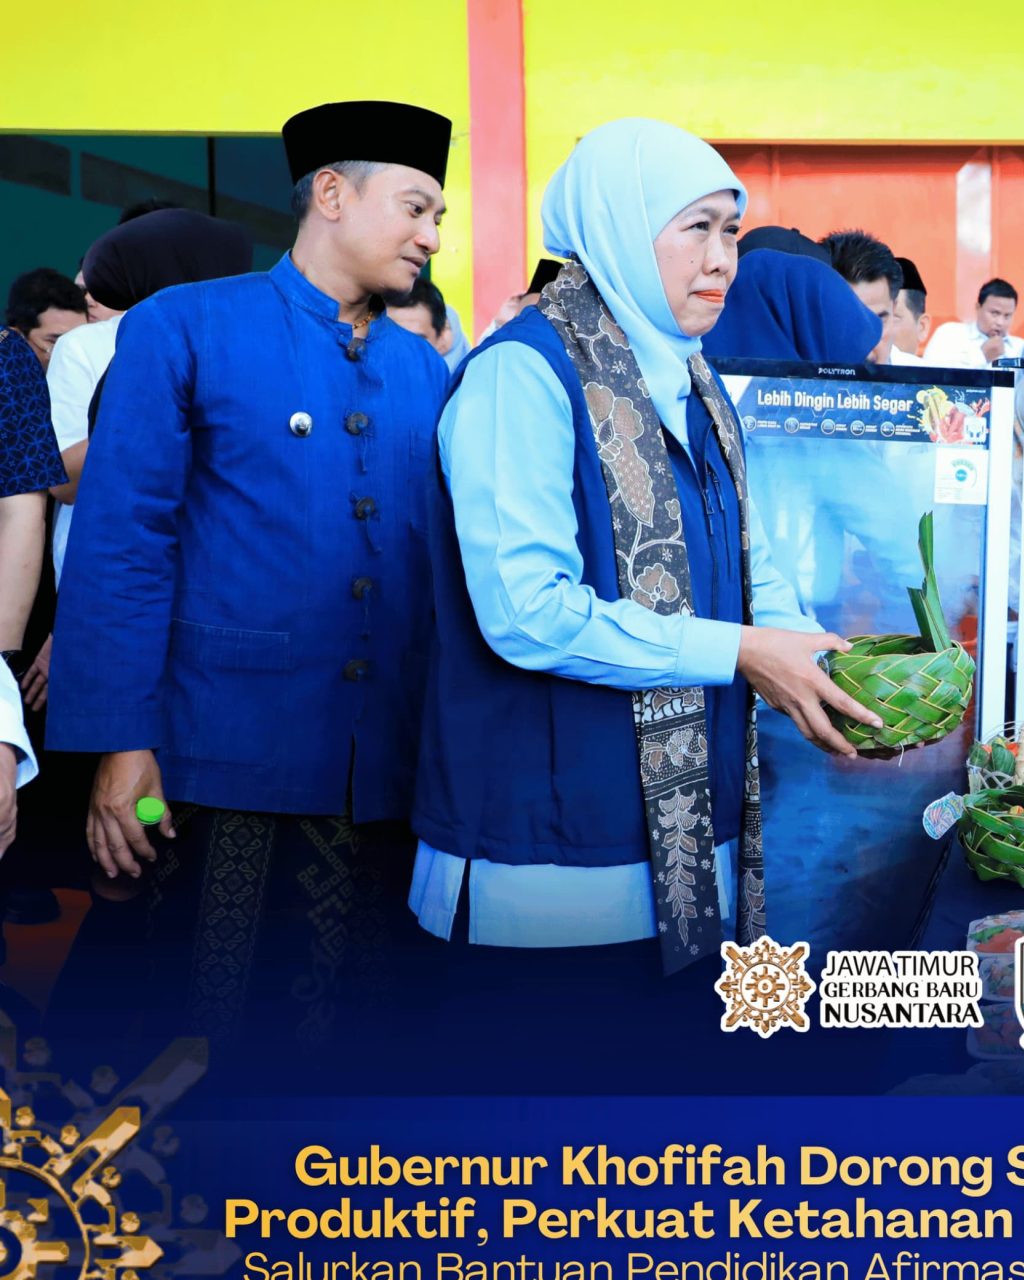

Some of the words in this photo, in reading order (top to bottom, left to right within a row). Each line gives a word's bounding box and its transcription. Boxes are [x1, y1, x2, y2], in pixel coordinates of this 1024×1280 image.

[757, 389, 791, 407] Lebih
[794, 391, 834, 412] Dingin
[837, 394, 870, 411] Lebih
[873, 395, 913, 415] Segar
